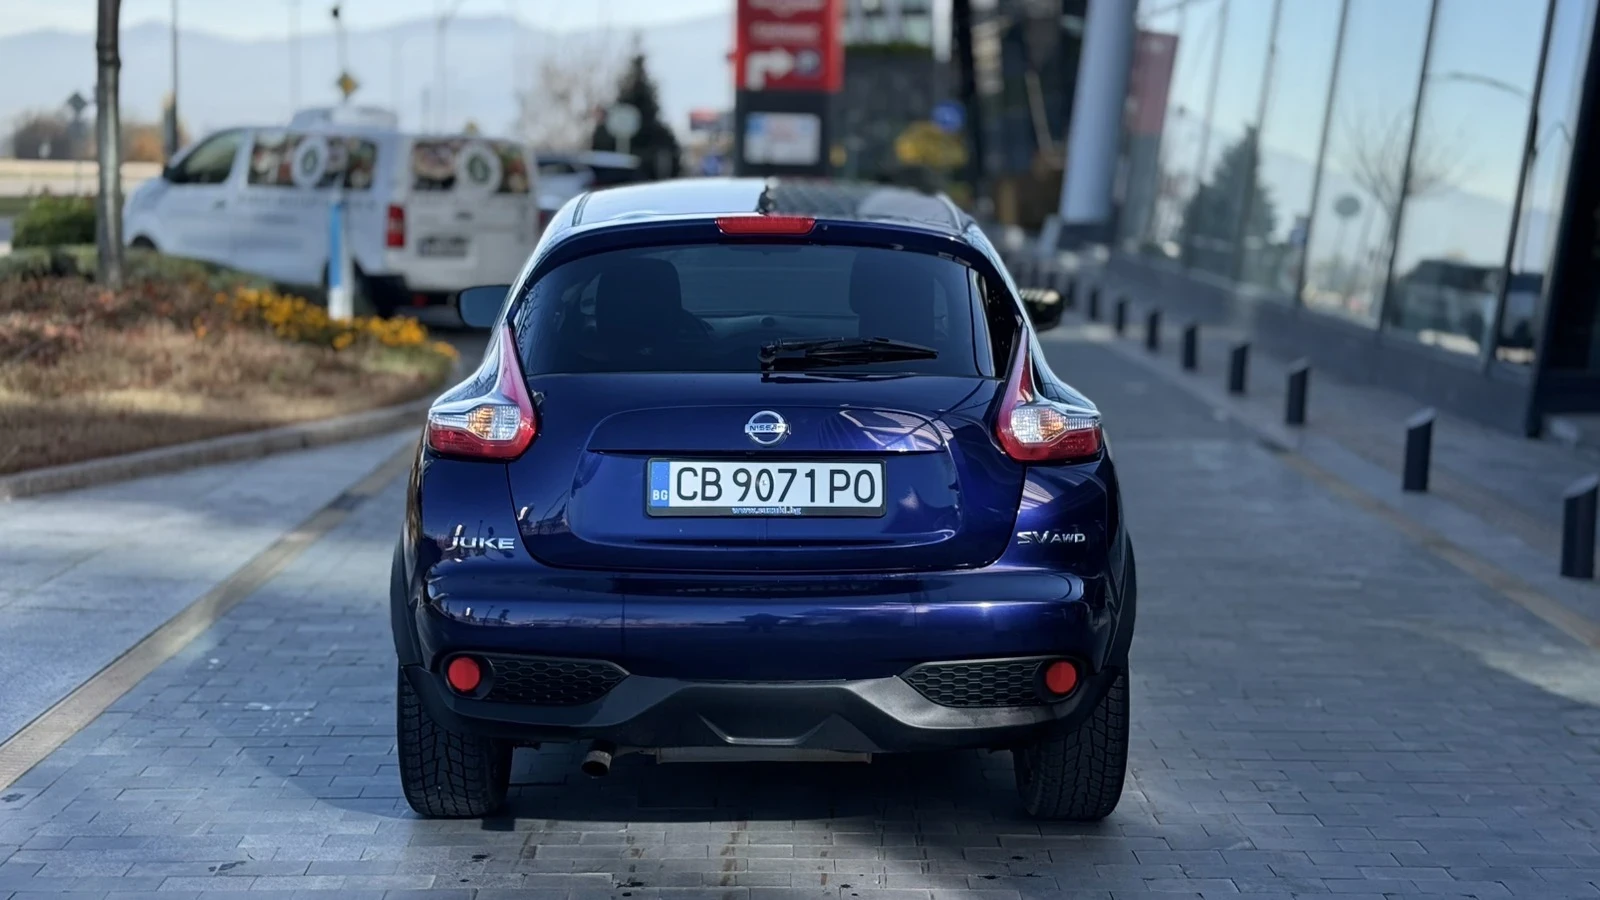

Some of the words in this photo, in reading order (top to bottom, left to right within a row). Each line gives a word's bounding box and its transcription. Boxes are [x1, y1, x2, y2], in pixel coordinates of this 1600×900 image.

[652, 489, 668, 501] BG
[676, 466, 723, 502] CB
[732, 467, 817, 503] 9071
[829, 468, 876, 504] PO
[445, 524, 516, 551] JUKE
[1016, 530, 1050, 545] SV
[1050, 533, 1087, 544] AWD
